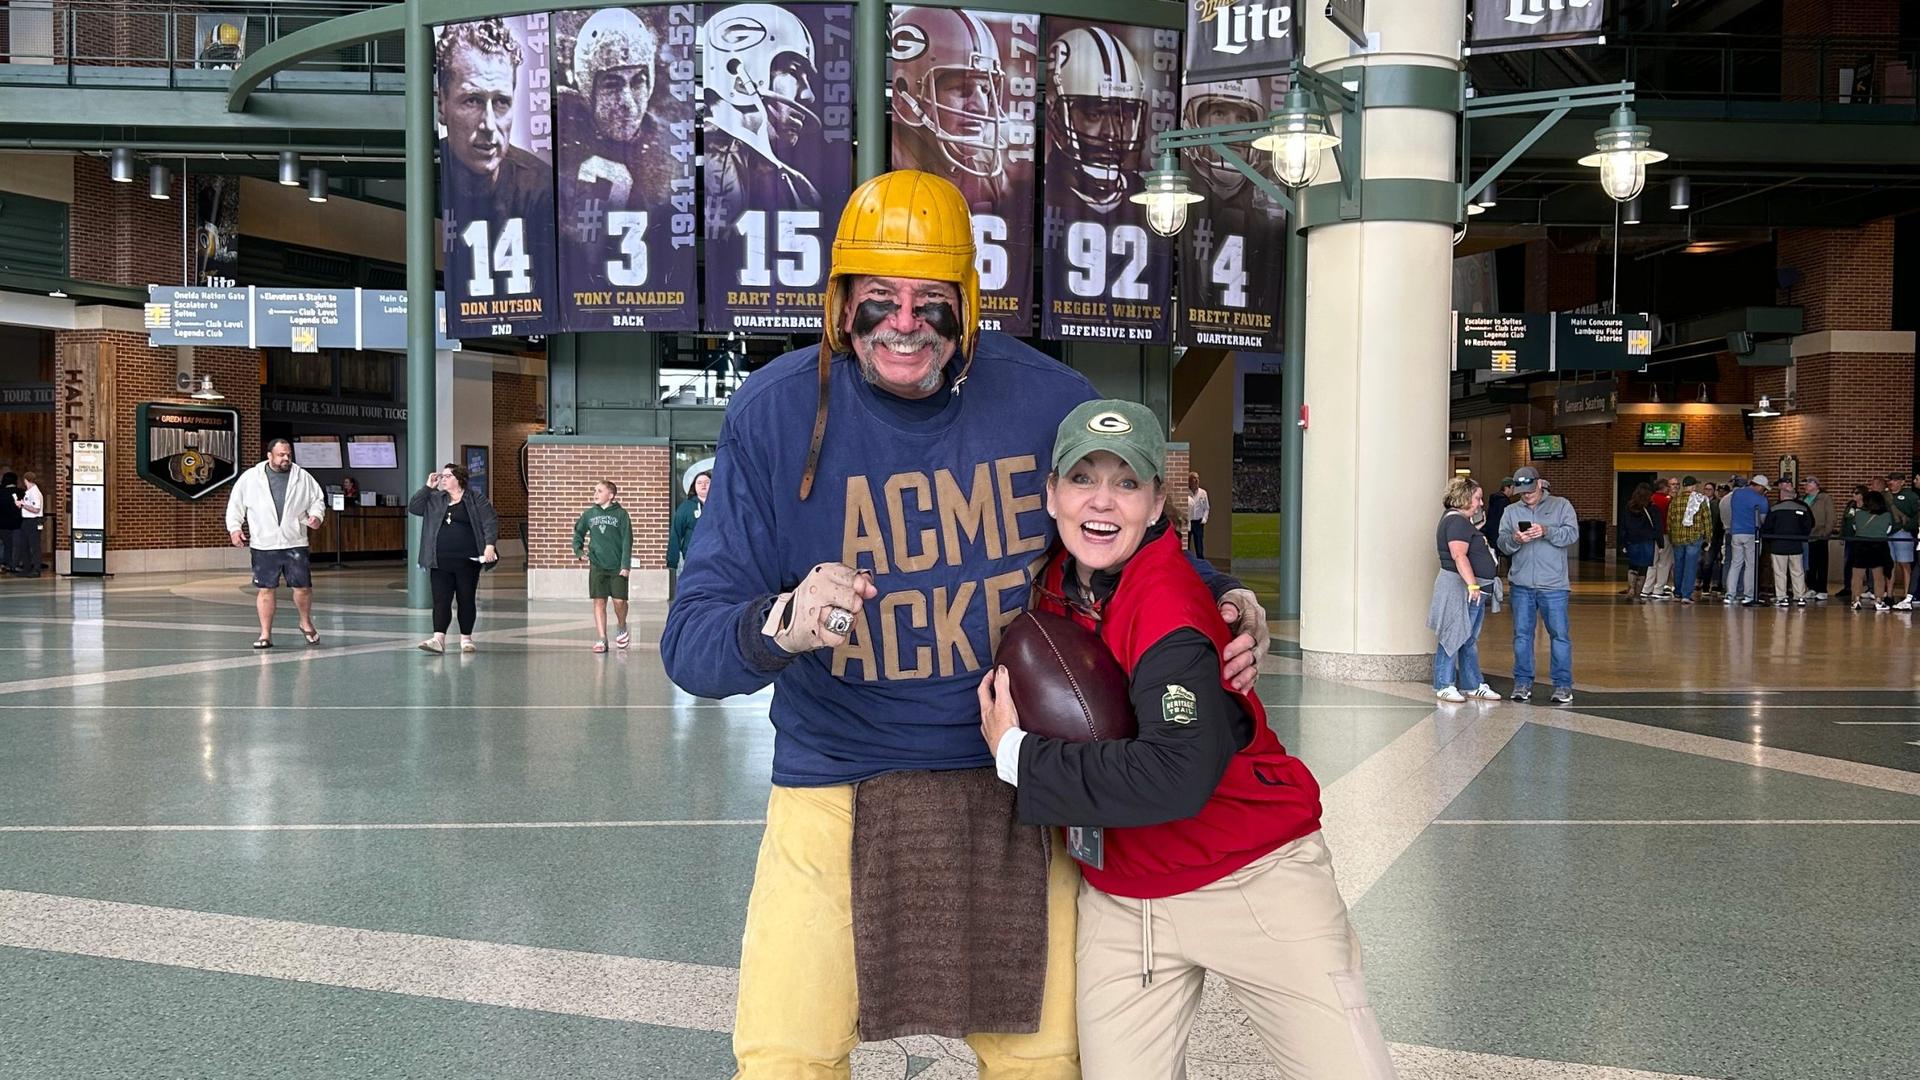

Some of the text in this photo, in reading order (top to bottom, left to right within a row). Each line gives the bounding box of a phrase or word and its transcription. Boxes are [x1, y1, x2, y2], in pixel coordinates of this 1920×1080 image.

[1212, 4, 1291, 55] Lite
[823, 5, 852, 144] 1956-71
[526, 11, 550, 154] 1935-45
[1008, 15, 1037, 164] 1958-72
[669, 4, 696, 251] 1941-44 46-52
[174, 291, 245, 301] Oneida Nation Gate
[264, 293, 298, 301] Elevators
[306, 293, 327, 301] Stairs
[379, 295, 398, 303] Main
[574, 291, 685, 305] TONY CANADEO
[727, 291, 770, 305] BART
[174, 301, 218, 309] Escalator to
[384, 306, 408, 314] Lambe
[460, 298, 543, 316] DON HUTSON
[980, 297, 1019, 311] CHKE
[174, 310, 197, 318] Suites
[299, 308, 316, 316] Club
[317, 308, 338, 316] Level
[1053, 301, 1162, 320] REGGIE WHITE
[205, 320, 222, 328] Club
[223, 320, 243, 328] Level
[289, 316, 338, 325] Legends Club
[612, 315, 644, 327] BACK
[733, 316, 823, 328] QUARTERBACK
[1189, 308, 1272, 328] BRETT FAVRE
[1571, 318, 1623, 326] Main Concourse
[174, 329, 223, 338] Legends Club
[491, 324, 512, 336] END
[1061, 324, 1153, 340] DEFENSIVE END
[1483, 332, 1509, 340] Legends
[1606, 327, 1623, 335] Field
[1196, 332, 1263, 347] QUARTERBACK
[1472, 339, 1507, 347] Restrooms
[3, 388, 32, 403] TOUR
[64, 369, 84, 429] HALL
[1565, 396, 1606, 413] General Seating
[321, 403, 359, 417] STADIUM
[361, 406, 383, 419] TOUR
[384, 407, 408, 420] TICKE
[161, 415, 182, 423] GREEN
[183, 416, 195, 424] BAY
[841, 453, 1046, 575] ACME
[1166, 700, 1195, 710] HERITAGE
[1168, 707, 1194, 715] TRAIL
